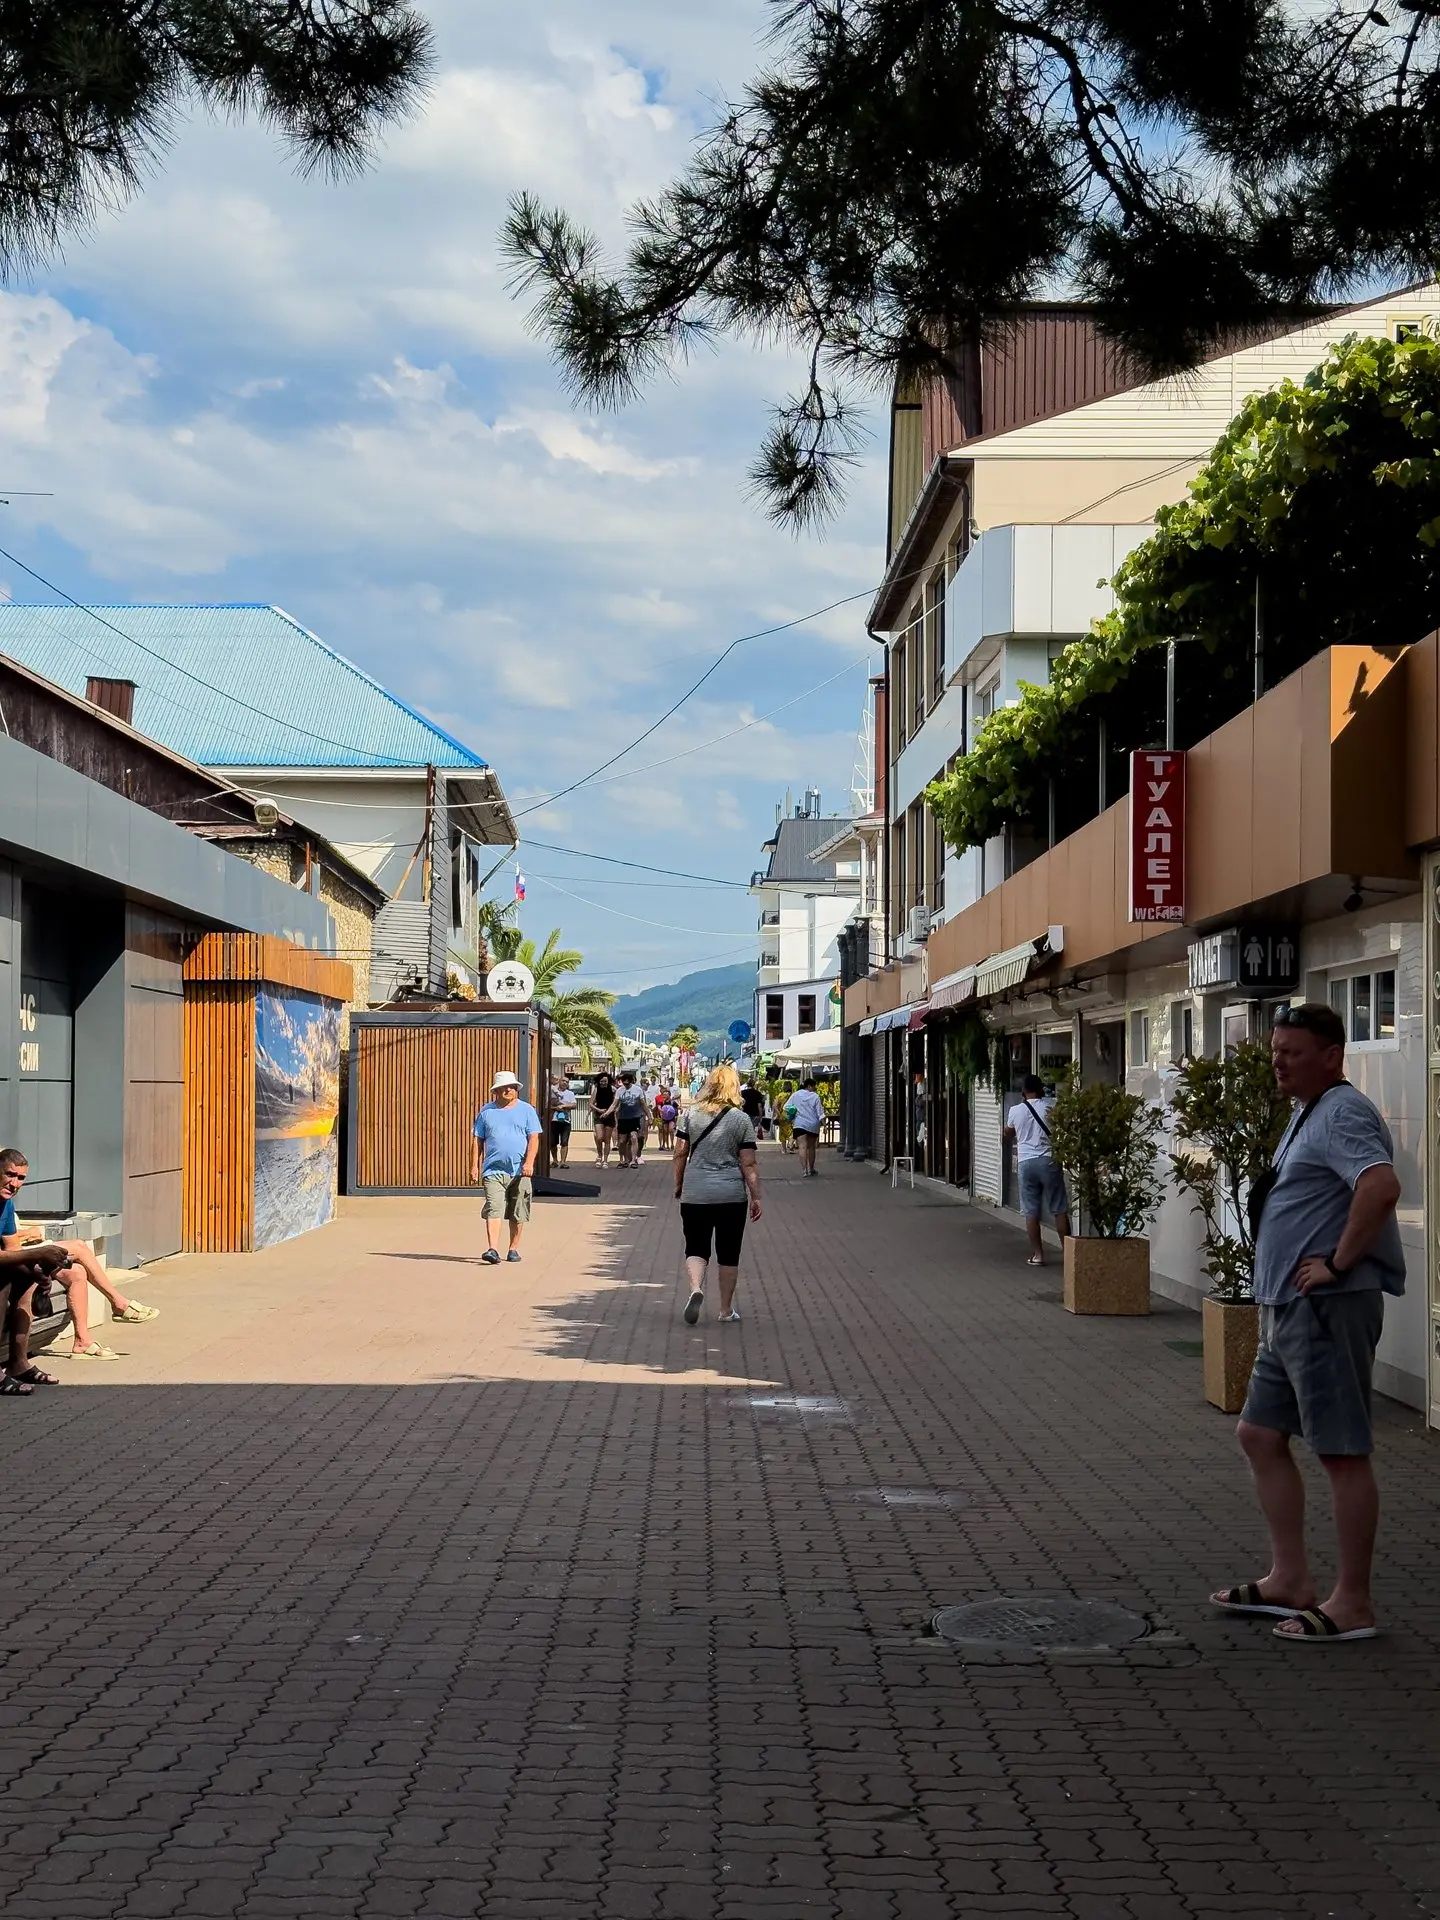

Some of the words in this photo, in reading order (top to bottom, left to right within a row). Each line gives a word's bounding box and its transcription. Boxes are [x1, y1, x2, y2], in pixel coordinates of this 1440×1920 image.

[1143, 755, 1173, 904] ТУАЛЕТ
[1134, 907, 1155, 920] WC
[1187, 935, 1222, 988] ТУАЛЕТ
